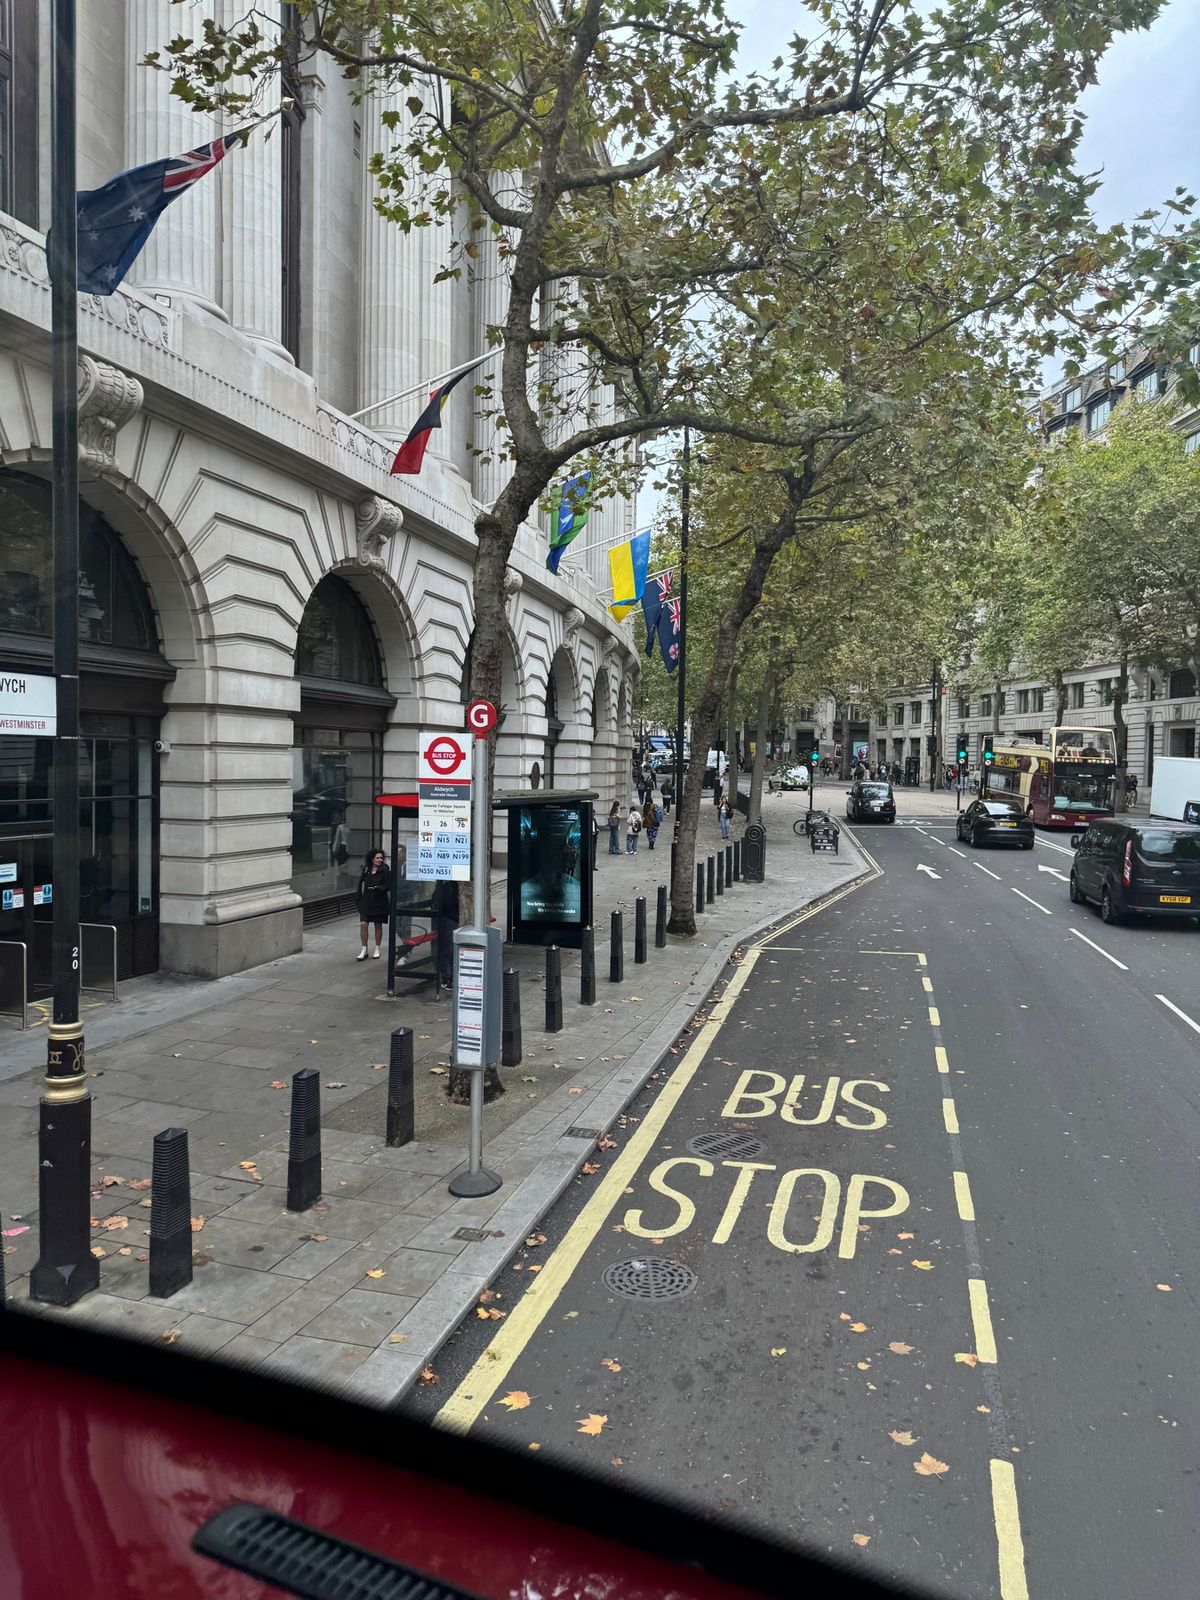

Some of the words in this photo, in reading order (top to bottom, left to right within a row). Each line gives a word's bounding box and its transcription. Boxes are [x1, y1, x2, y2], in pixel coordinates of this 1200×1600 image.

[0, 720, 45, 729] WESTMINSTER
[470, 704, 488, 727] G
[721, 1070, 891, 1130] BUS
[624, 1157, 910, 1259] STOP
